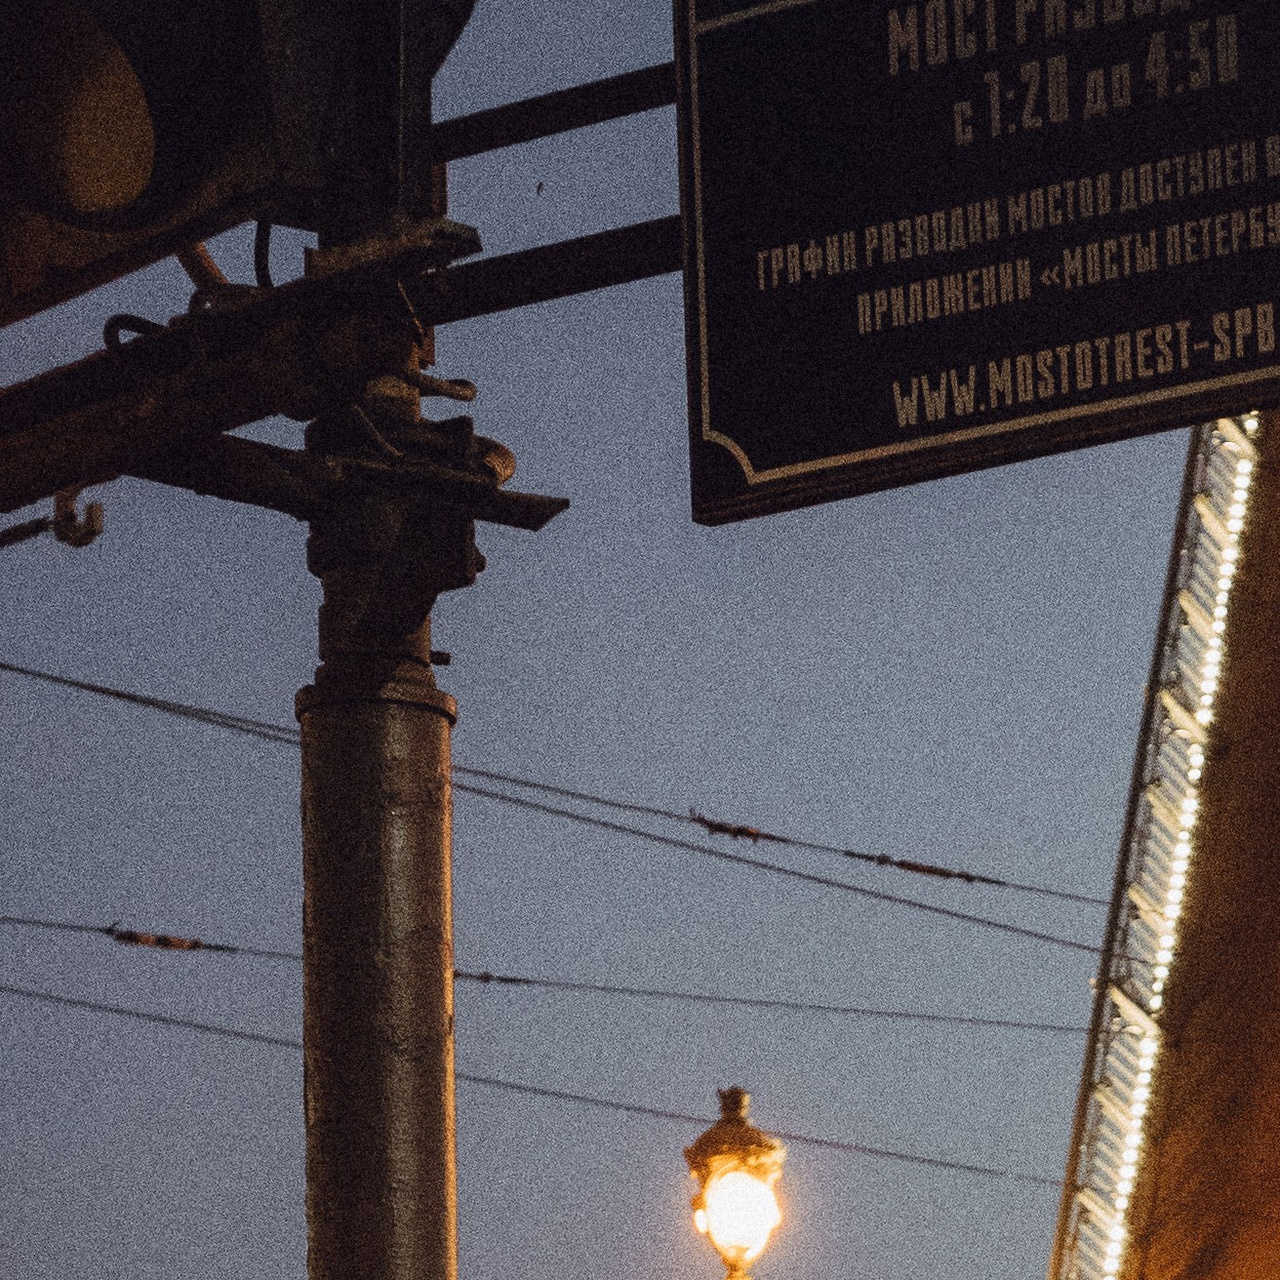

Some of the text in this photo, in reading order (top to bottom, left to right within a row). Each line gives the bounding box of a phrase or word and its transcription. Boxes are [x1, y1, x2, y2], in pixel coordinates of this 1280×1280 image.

[887, 0, 998, 75] МОСТ
[984, 53, 1070, 138] 1:20
[1144, 13, 1240, 99] 4:50
[757, 230, 858, 291] ГРАФИК
[864, 198, 1000, 267] РАЗВОДКИ
[1008, 172, 1112, 235] МОСТОВ
[1119, 140, 1258, 213] ДОСТУПЕН
[856, 257, 1033, 336] ПРИЛОЖЕНИИ
[1039, 228, 1158, 290] «МОСТЫ
